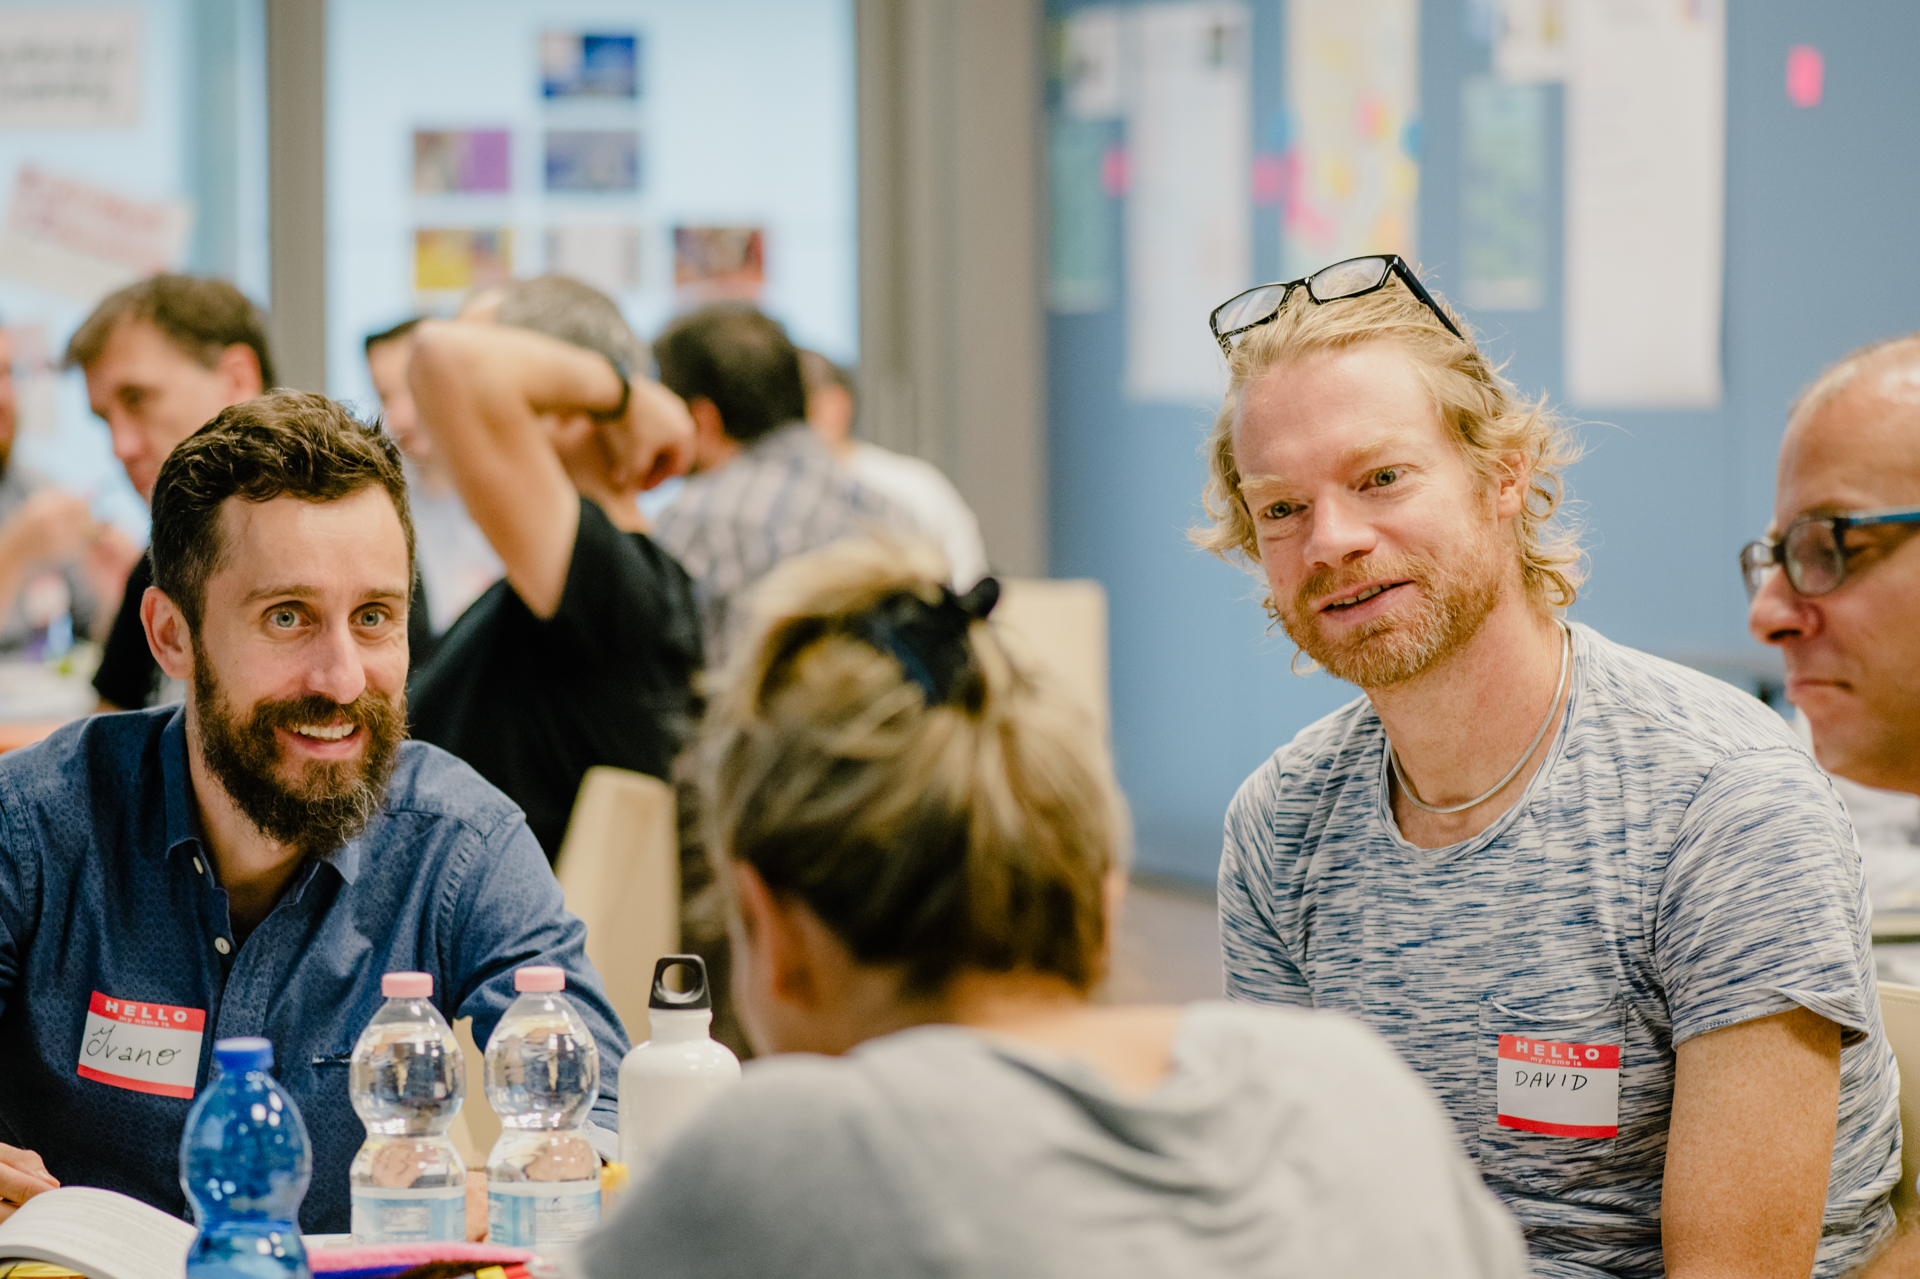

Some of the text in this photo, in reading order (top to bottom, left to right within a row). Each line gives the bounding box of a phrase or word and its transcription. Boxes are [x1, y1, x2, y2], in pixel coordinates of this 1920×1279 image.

[105, 999, 187, 1023] HELLO
[118, 1016, 132, 1024] my
[135, 1018, 159, 1027] name
[1516, 1040, 1600, 1061] HELLO
[1530, 1056, 1543, 1064] my
[1546, 1058, 1571, 1066] name
[1515, 1070, 1588, 1091] DAVID
